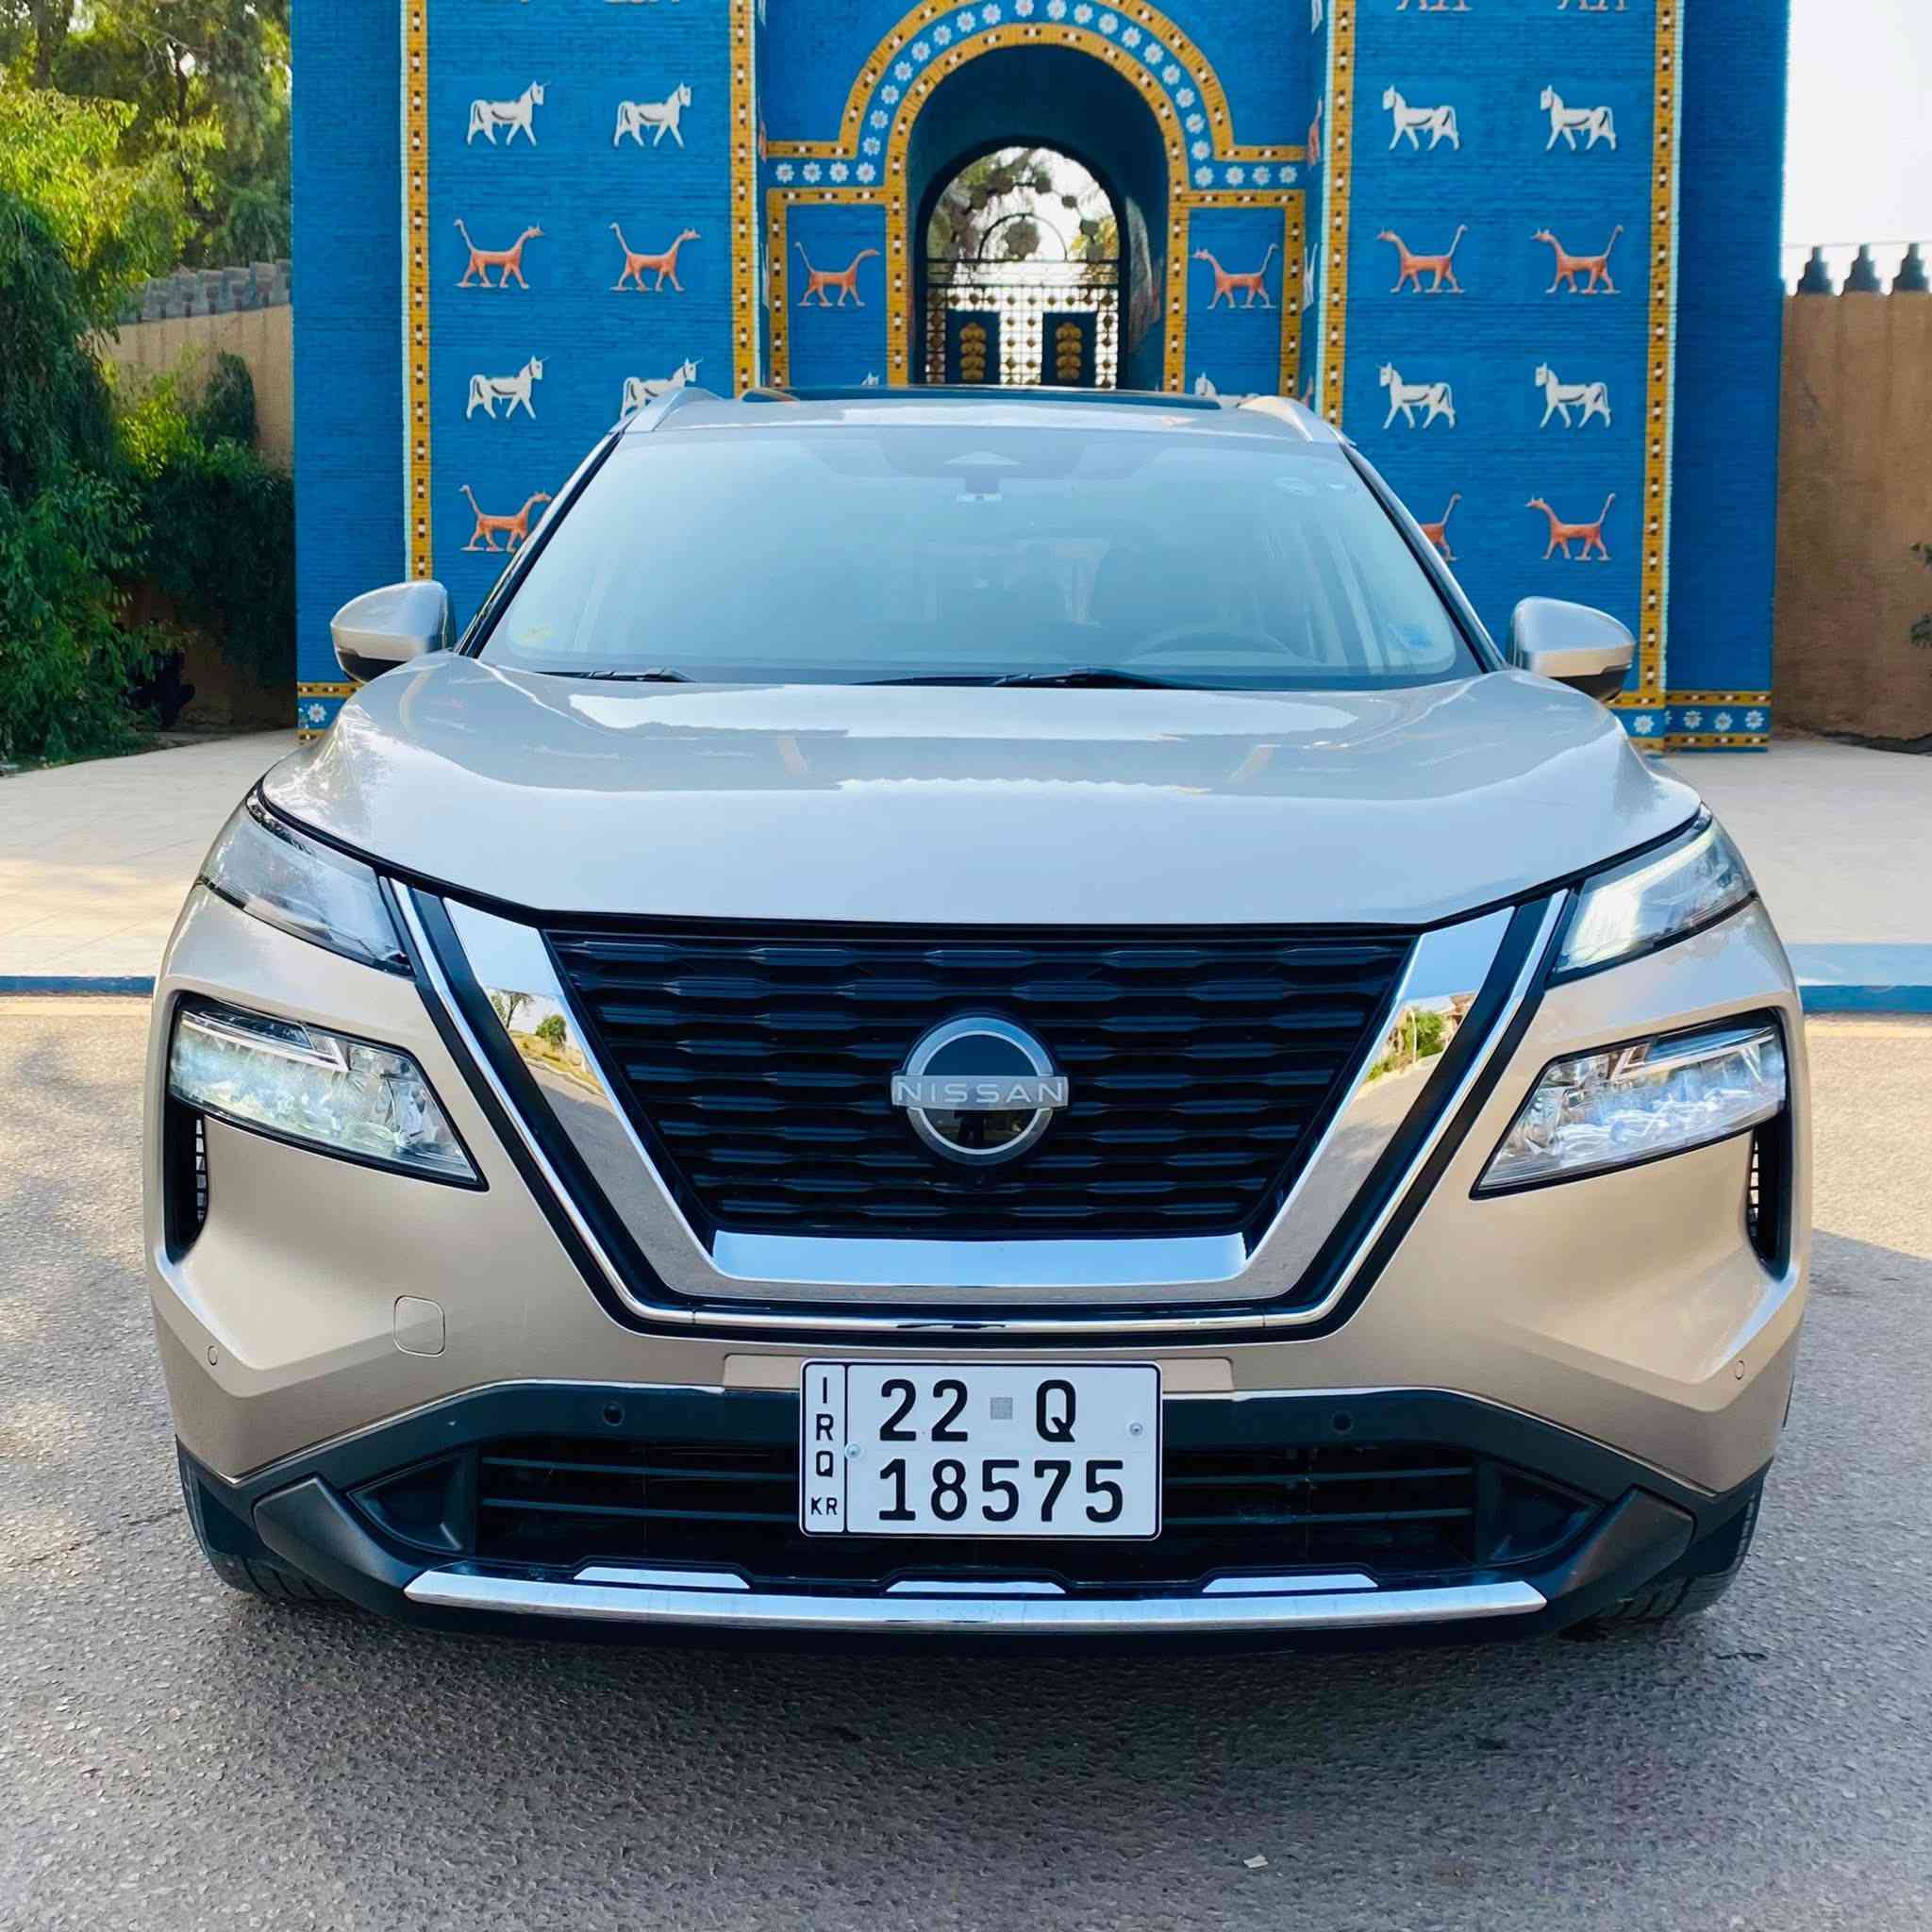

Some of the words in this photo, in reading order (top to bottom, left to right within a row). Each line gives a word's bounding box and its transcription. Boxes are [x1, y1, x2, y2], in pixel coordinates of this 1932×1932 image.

[897, 1081, 1062, 1103] NISSAN
[815, 1376, 834, 1478] IRQ
[879, 1378, 968, 1441] 22
[1037, 1378, 1076, 1442] Q
[810, 1497, 838, 1516] KR
[878, 1458, 1124, 1523] 18575
